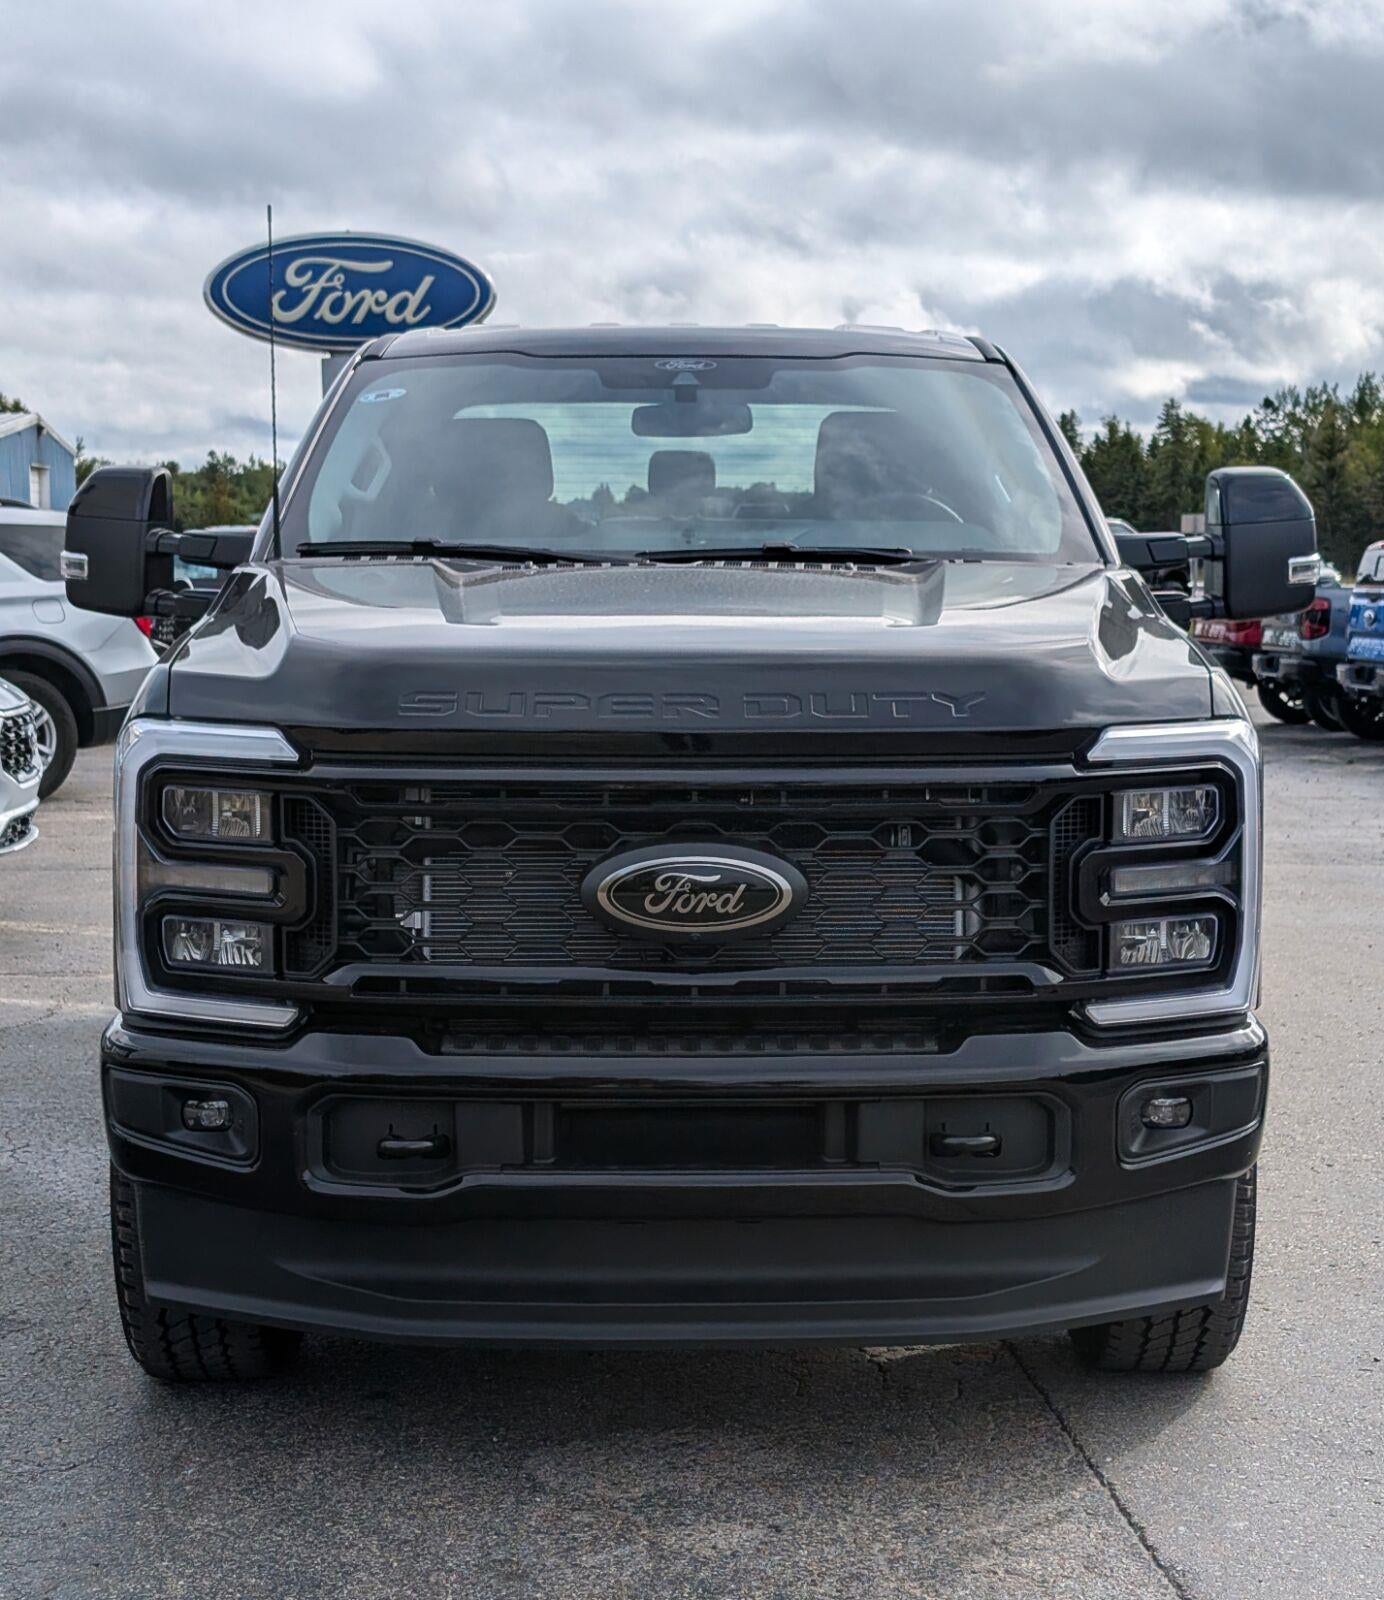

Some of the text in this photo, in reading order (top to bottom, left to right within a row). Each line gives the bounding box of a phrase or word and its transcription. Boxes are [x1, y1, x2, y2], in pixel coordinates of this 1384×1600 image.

[272, 257, 435, 324] Ford
[398, 690, 987, 719] SUPER DUTY
[644, 872, 747, 914] Ford
